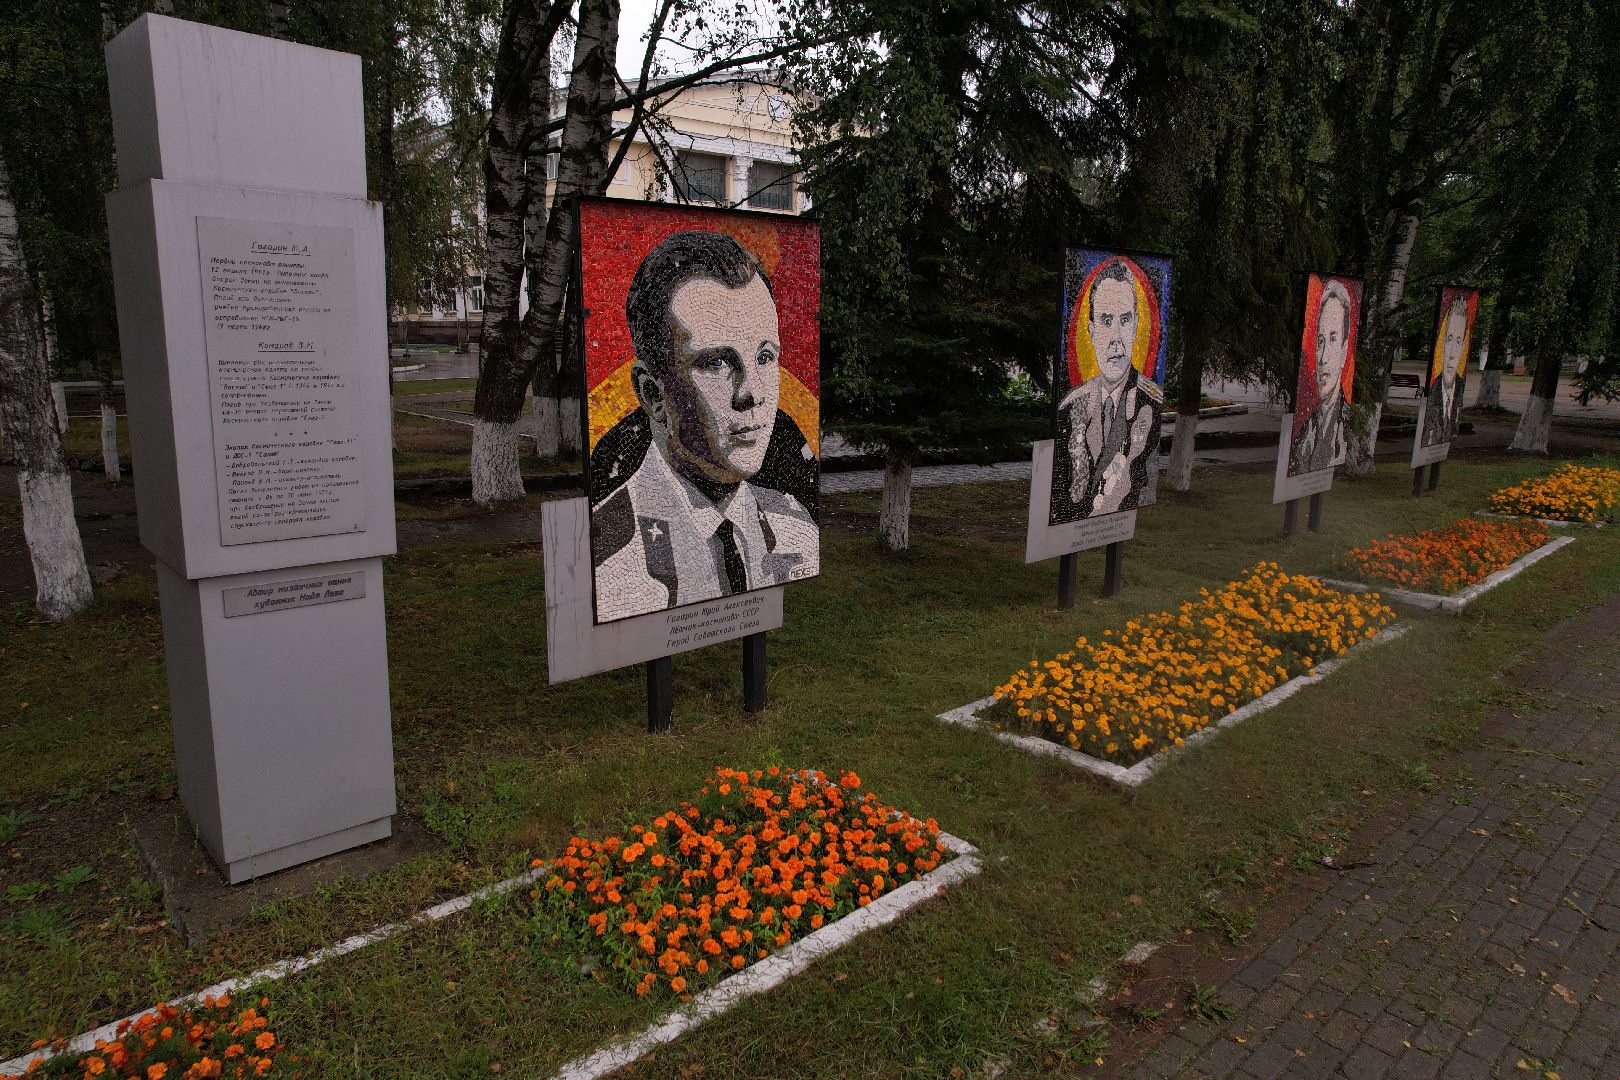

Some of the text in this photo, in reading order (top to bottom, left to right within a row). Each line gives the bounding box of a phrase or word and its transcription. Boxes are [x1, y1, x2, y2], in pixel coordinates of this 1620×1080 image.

[252, 242, 288, 252] Гагарин
[259, 342, 293, 350] Комаров
[248, 589, 274, 598] Автор
[278, 582, 324, 594] мозаичных
[255, 590, 344, 609] художник Надя Леже
[667, 597, 765, 624] Гагарин Юрий Алексеевич
[743, 608, 760, 618] СССР
[667, 620, 760, 648] Герой Советского Союза
